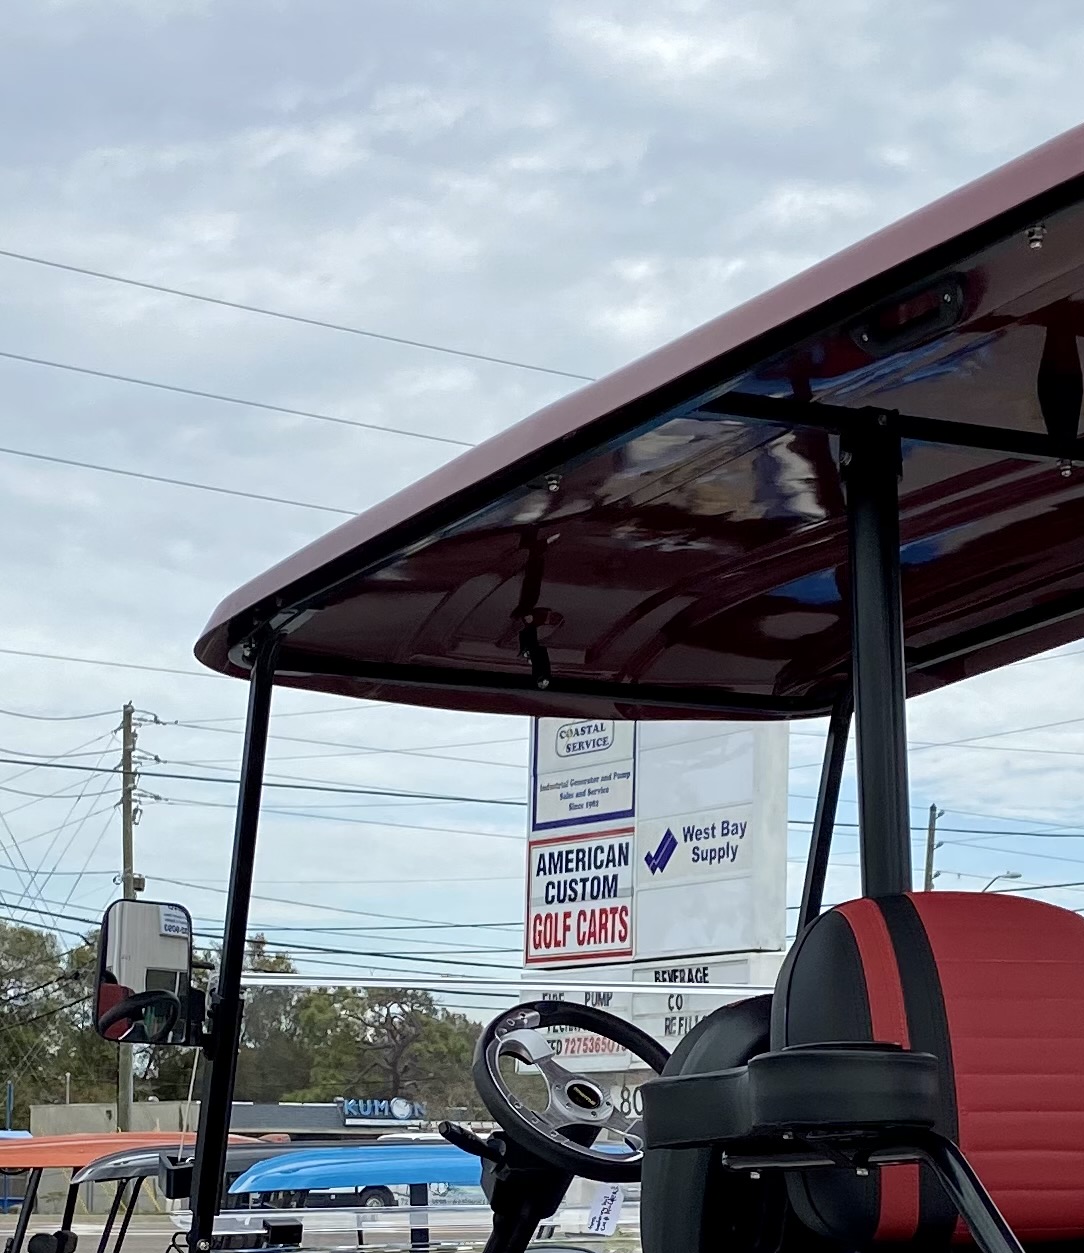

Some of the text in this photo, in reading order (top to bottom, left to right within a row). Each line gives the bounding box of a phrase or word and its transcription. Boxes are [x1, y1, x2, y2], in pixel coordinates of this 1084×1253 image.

[559, 722, 606, 740] COASTAL
[565, 736, 609, 753] SERVICE
[540, 771, 631, 792] Industrial Generator and Pump
[559, 787, 609, 801] Sales and Service
[568, 802, 584, 811] Since
[682, 820, 747, 843] West Bay
[536, 842, 630, 877] AMERICAN
[691, 841, 739, 866] Supply
[544, 873, 619, 905] CUSTOM
[533, 905, 629, 950] GOLF CARTS
[654, 966, 710, 984] BEVERAGE
[584, 991, 614, 1007] PUMP
[343, 1097, 428, 1120] KUMON
